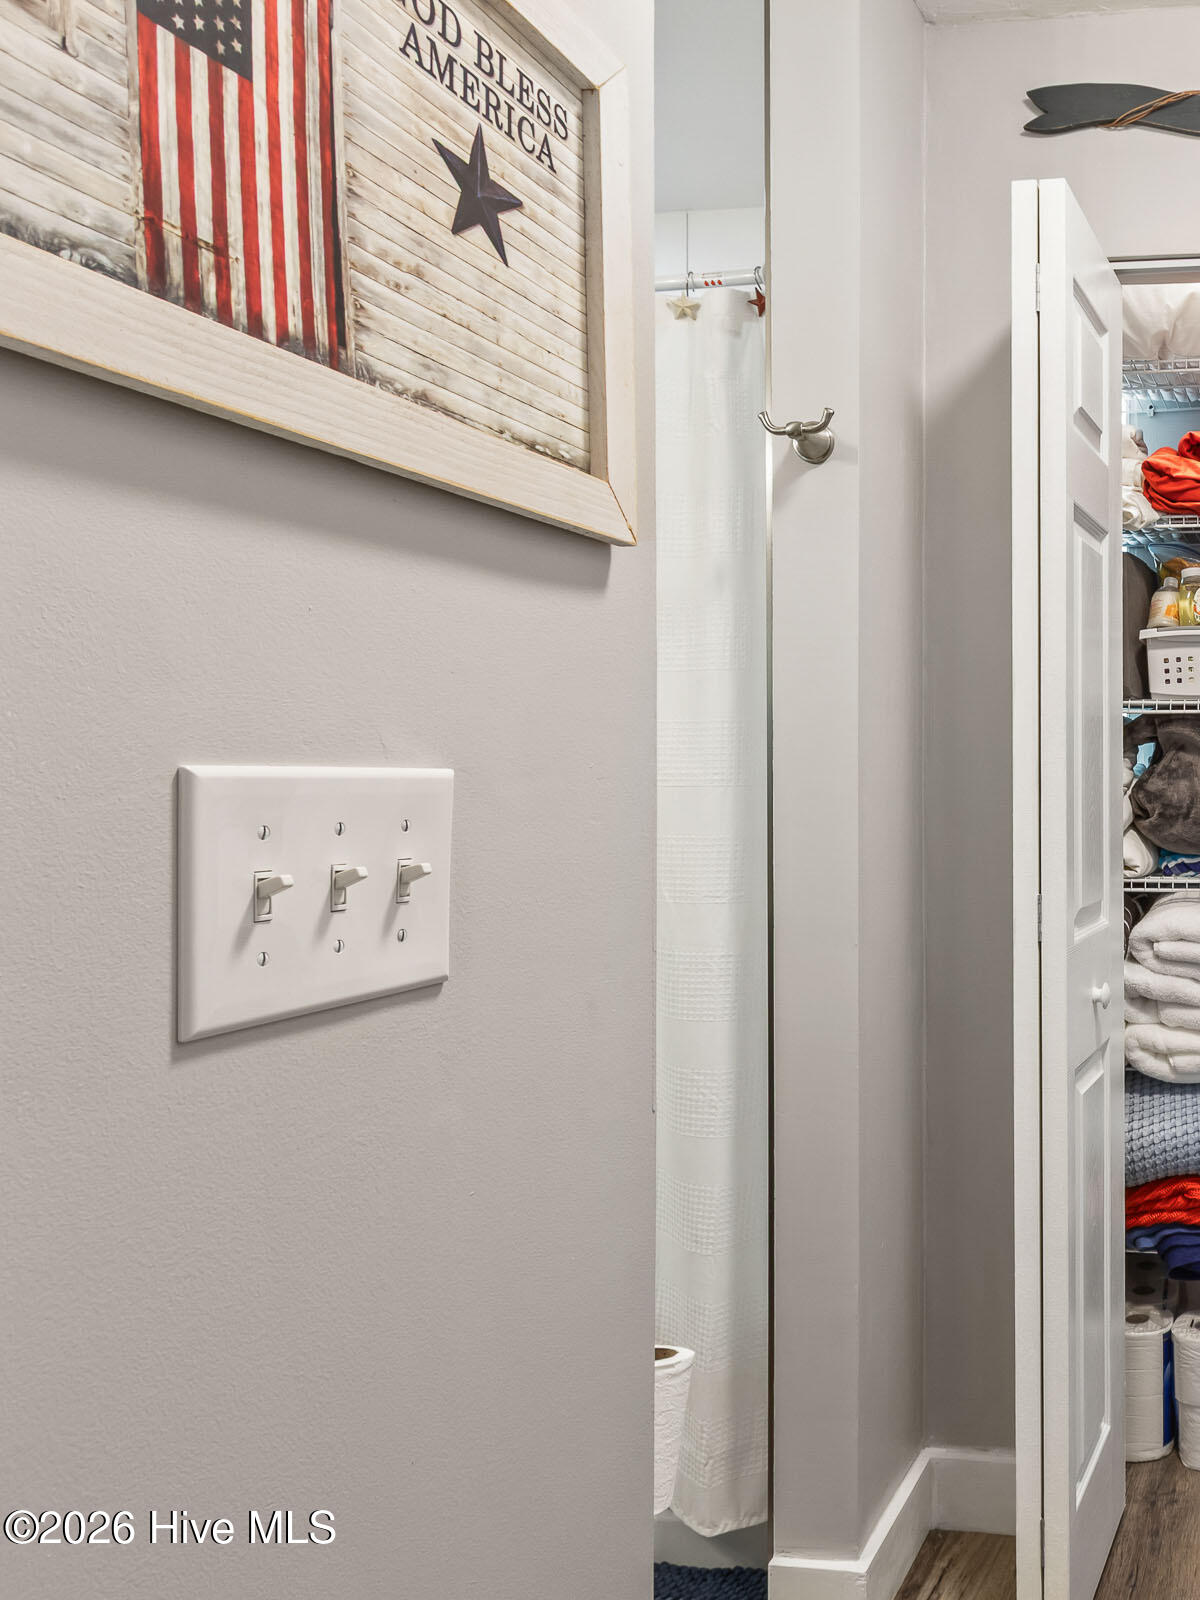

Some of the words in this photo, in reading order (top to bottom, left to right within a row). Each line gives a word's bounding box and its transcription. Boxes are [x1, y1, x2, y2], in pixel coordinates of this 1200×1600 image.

[397, 0, 462, 48] OD
[473, 30, 569, 141] BLESS
[399, 22, 557, 174] AMERICA
